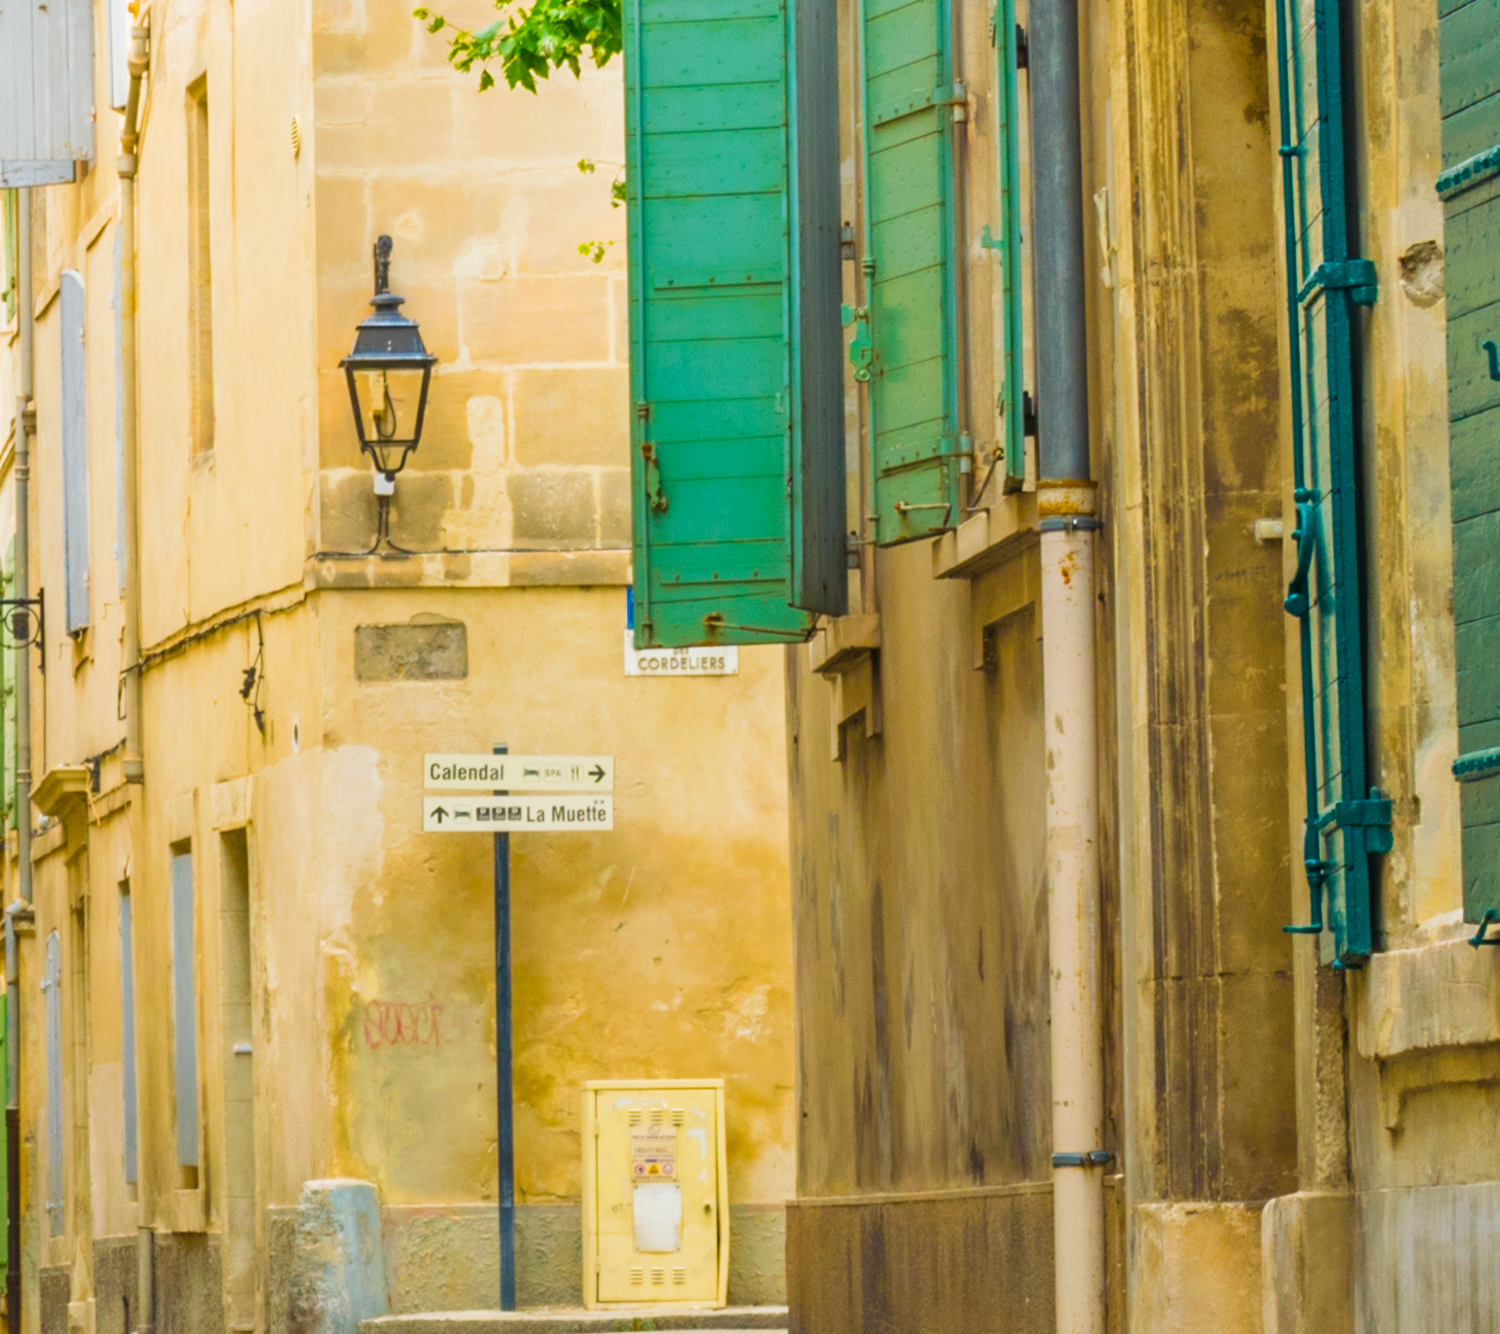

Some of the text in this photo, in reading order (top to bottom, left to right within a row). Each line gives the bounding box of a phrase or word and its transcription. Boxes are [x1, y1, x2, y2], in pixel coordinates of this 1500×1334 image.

[638, 657, 725, 670] CORDELIERS
[430, 763, 561, 780] Calendal SPA
[527, 805, 606, 822] La Muette
